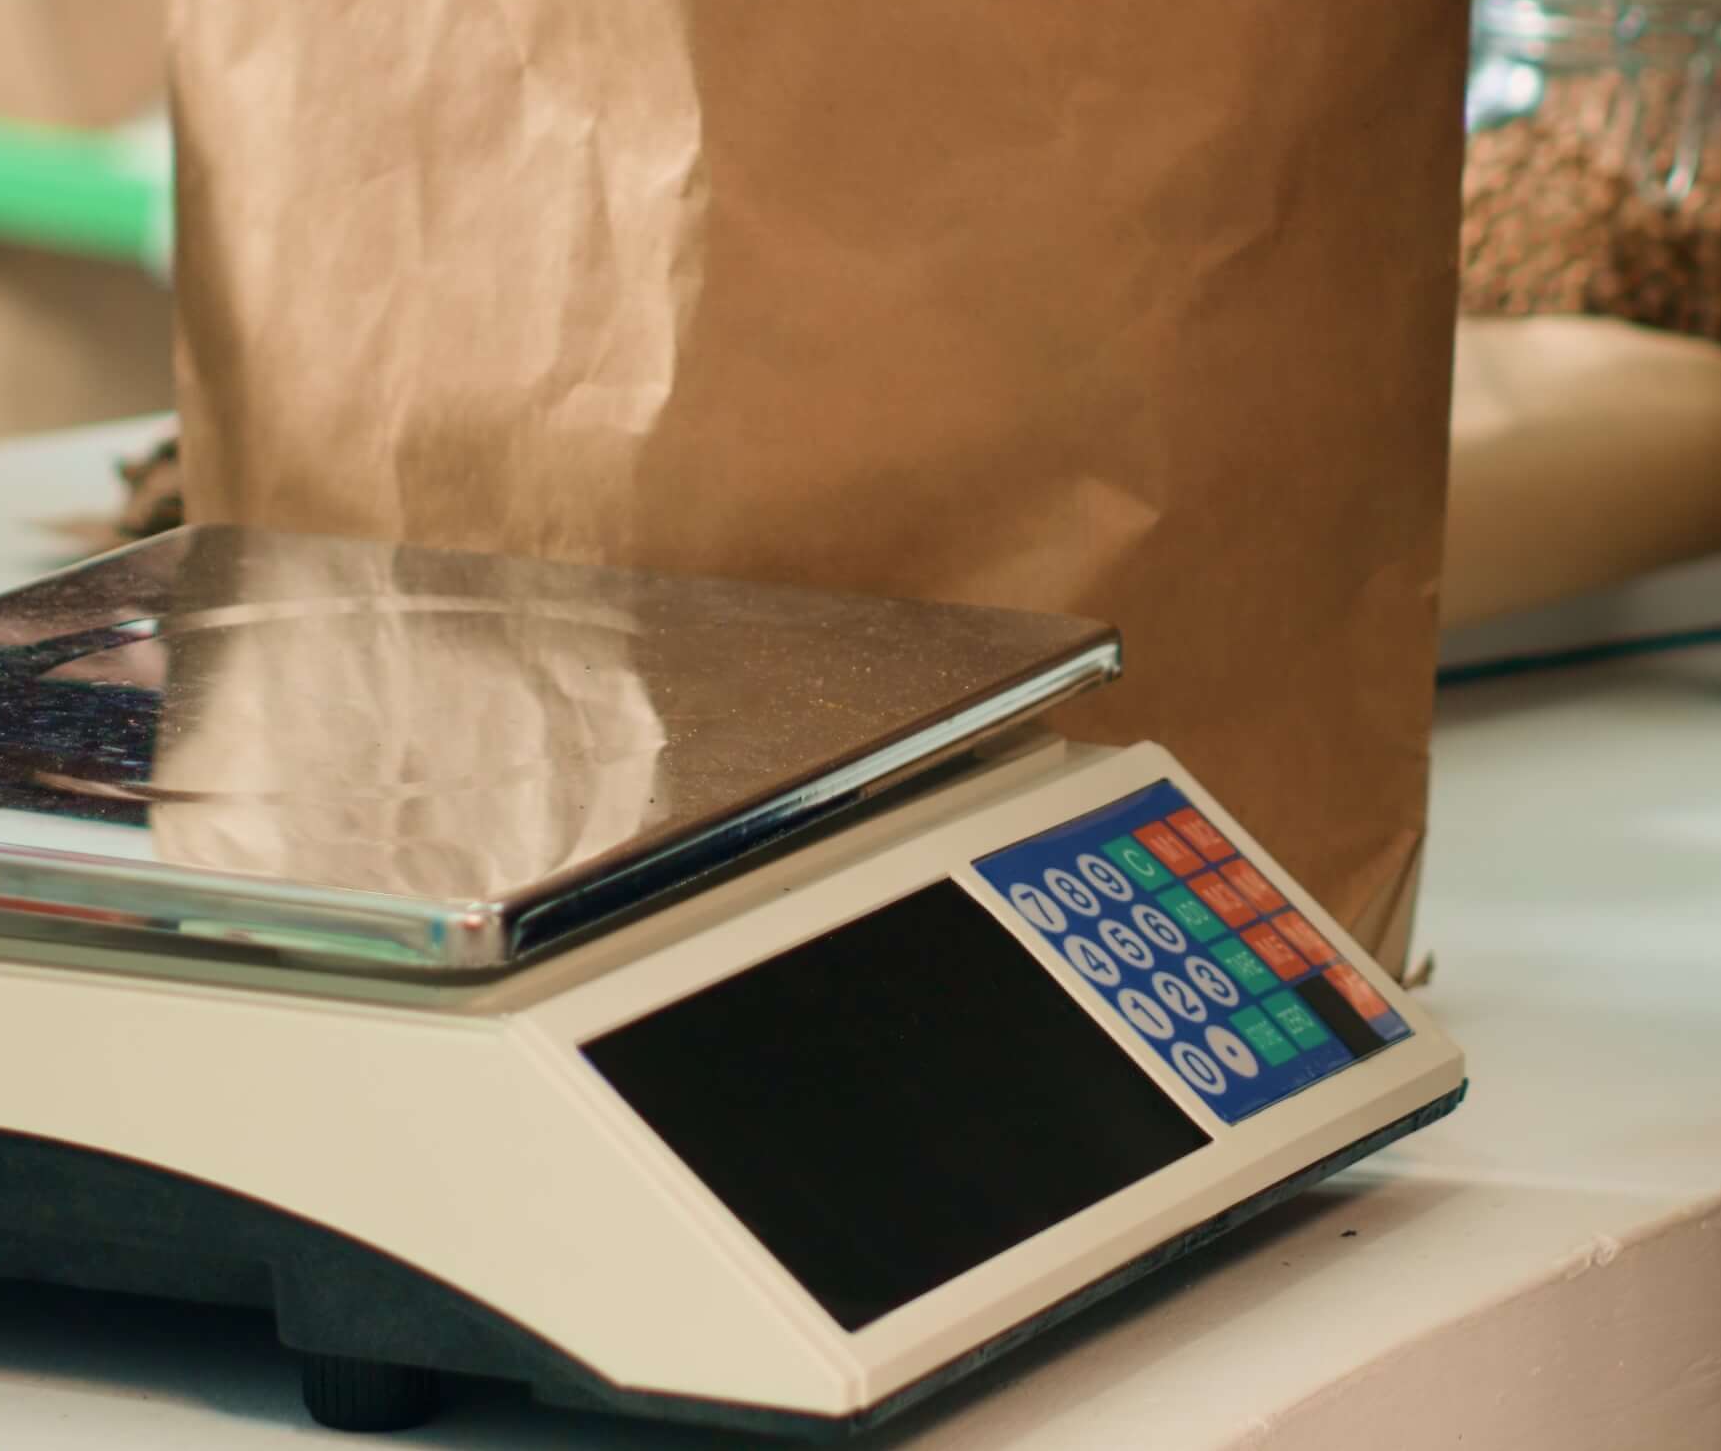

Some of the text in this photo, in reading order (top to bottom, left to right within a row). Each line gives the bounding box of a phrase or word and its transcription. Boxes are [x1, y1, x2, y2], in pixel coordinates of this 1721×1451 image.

[1088, 861, 1124, 894] 9
[1123, 849, 1156, 877] C
[1020, 891, 1054, 925] 7
[1055, 876, 1092, 909] 8
[1108, 927, 1145, 961] 5
[1142, 912, 1179, 944] 6
[1079, 943, 1113, 975] 4
[1162, 980, 1200, 1015] 2
[1194, 964, 1231, 998] 3
[1130, 995, 1165, 1030] 1
[1181, 1050, 1218, 1086] 0
